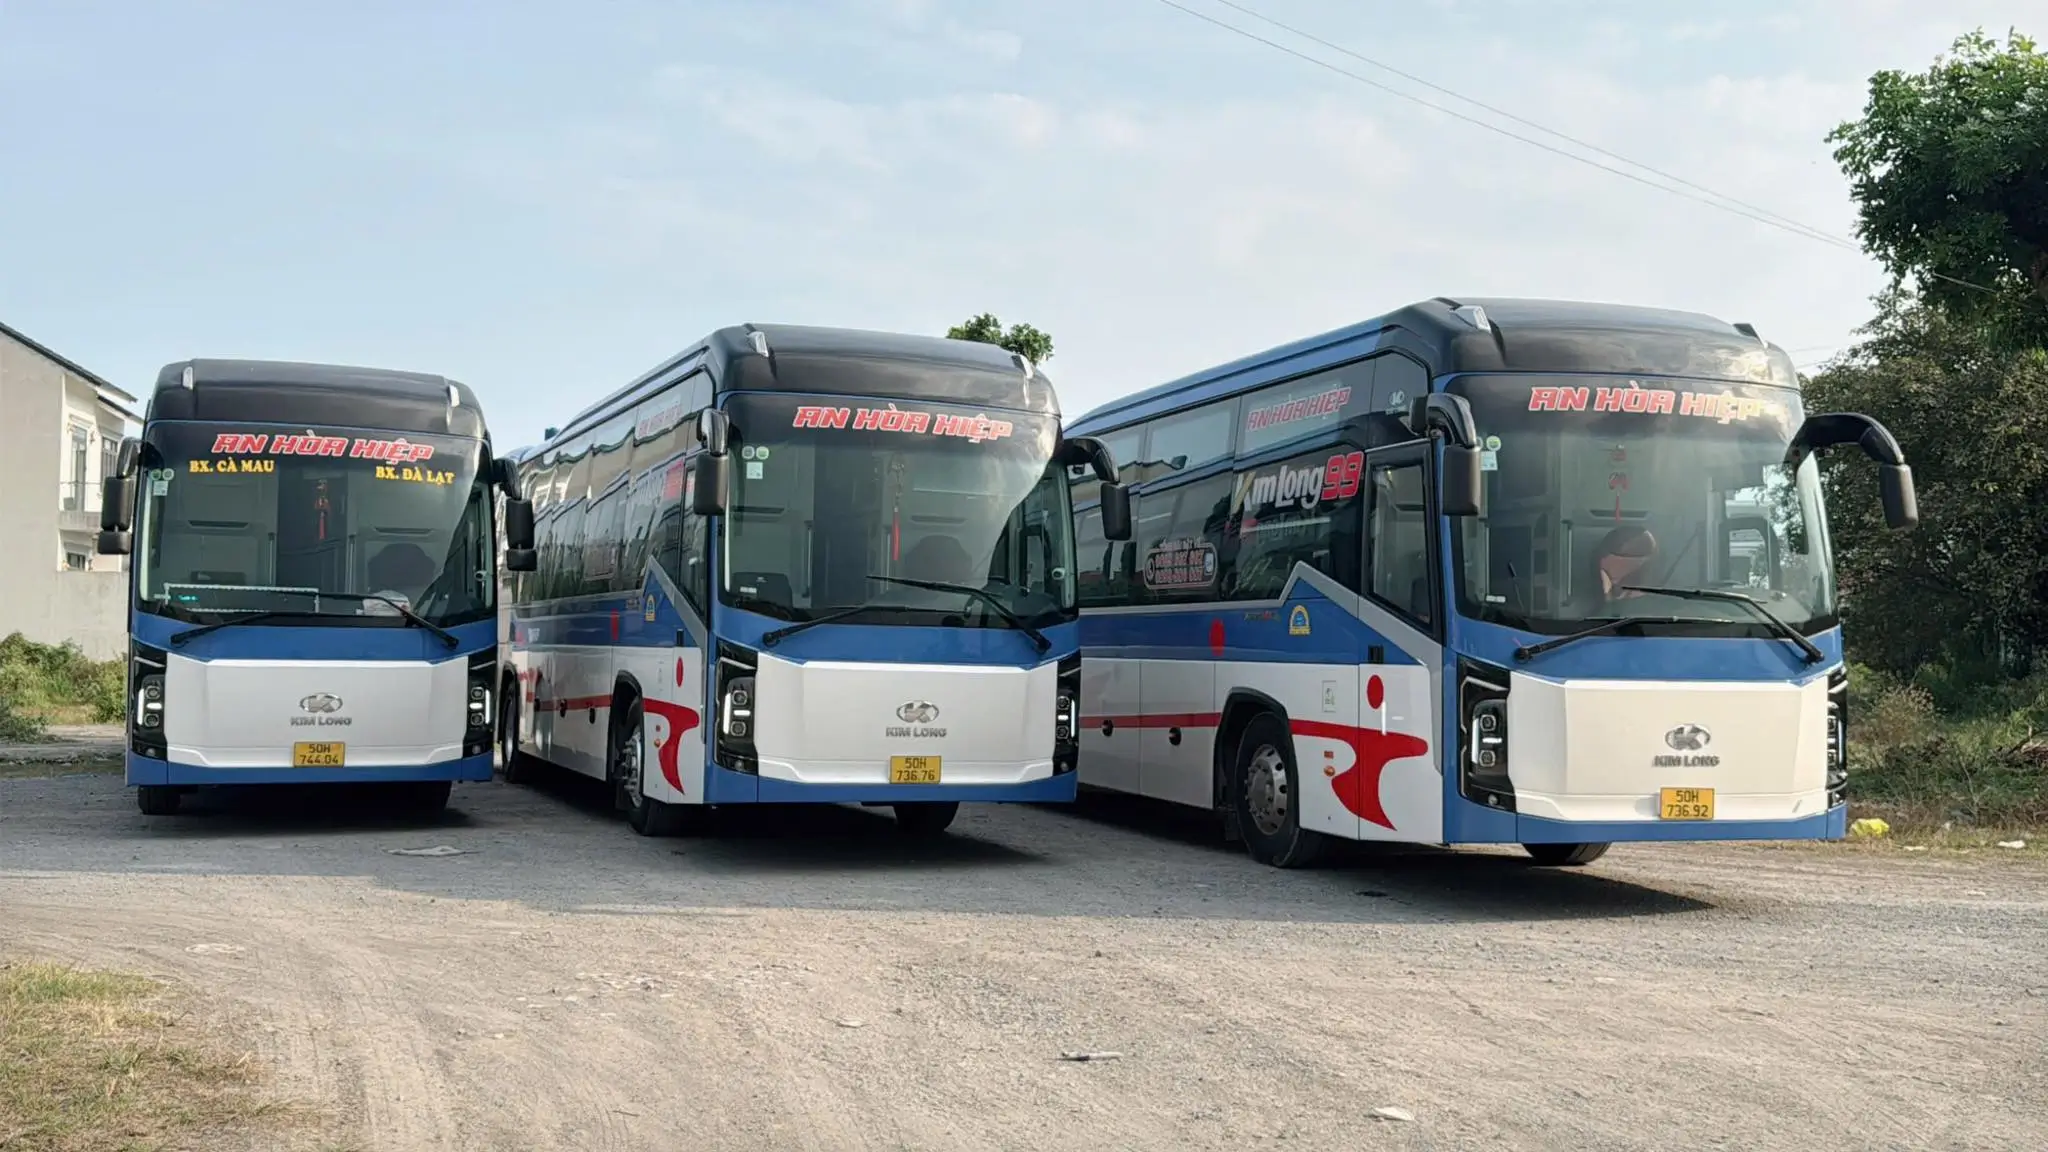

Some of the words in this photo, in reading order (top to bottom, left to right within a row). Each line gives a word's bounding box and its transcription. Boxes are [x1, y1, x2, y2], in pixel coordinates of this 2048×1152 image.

[1528, 387, 1590, 411] AN
[1593, 380, 1676, 414] HÒA
[1679, 390, 1762, 425] HIỆP
[793, 406, 850, 428] AN
[852, 403, 930, 434] HÒA
[932, 414, 1013, 443] HIỆP
[212, 434, 268, 454] AN
[270, 429, 348, 457] HÒA
[350, 438, 434, 464] HIỆP
[189, 460, 213, 472] BX.
[217, 457, 239, 472] CÀ
[241, 460, 274, 472] MAU
[375, 466, 399, 480] BX.
[402, 465, 423, 481] ĐÀ
[427, 470, 455, 485] LẠT
[290, 716, 316, 726] KIM
[318, 716, 352, 726] LONG
[886, 726, 911, 737] KIM
[913, 726, 947, 738] LONG
[308, 743, 331, 754] 50H
[904, 757, 927, 769] 50H
[1653, 755, 1681, 768] KIM
[1683, 755, 1720, 768] LONG
[896, 770, 935, 782] 736.76
[1675, 790, 1699, 803] 50H
[1666, 804, 1709, 818] 736.92
